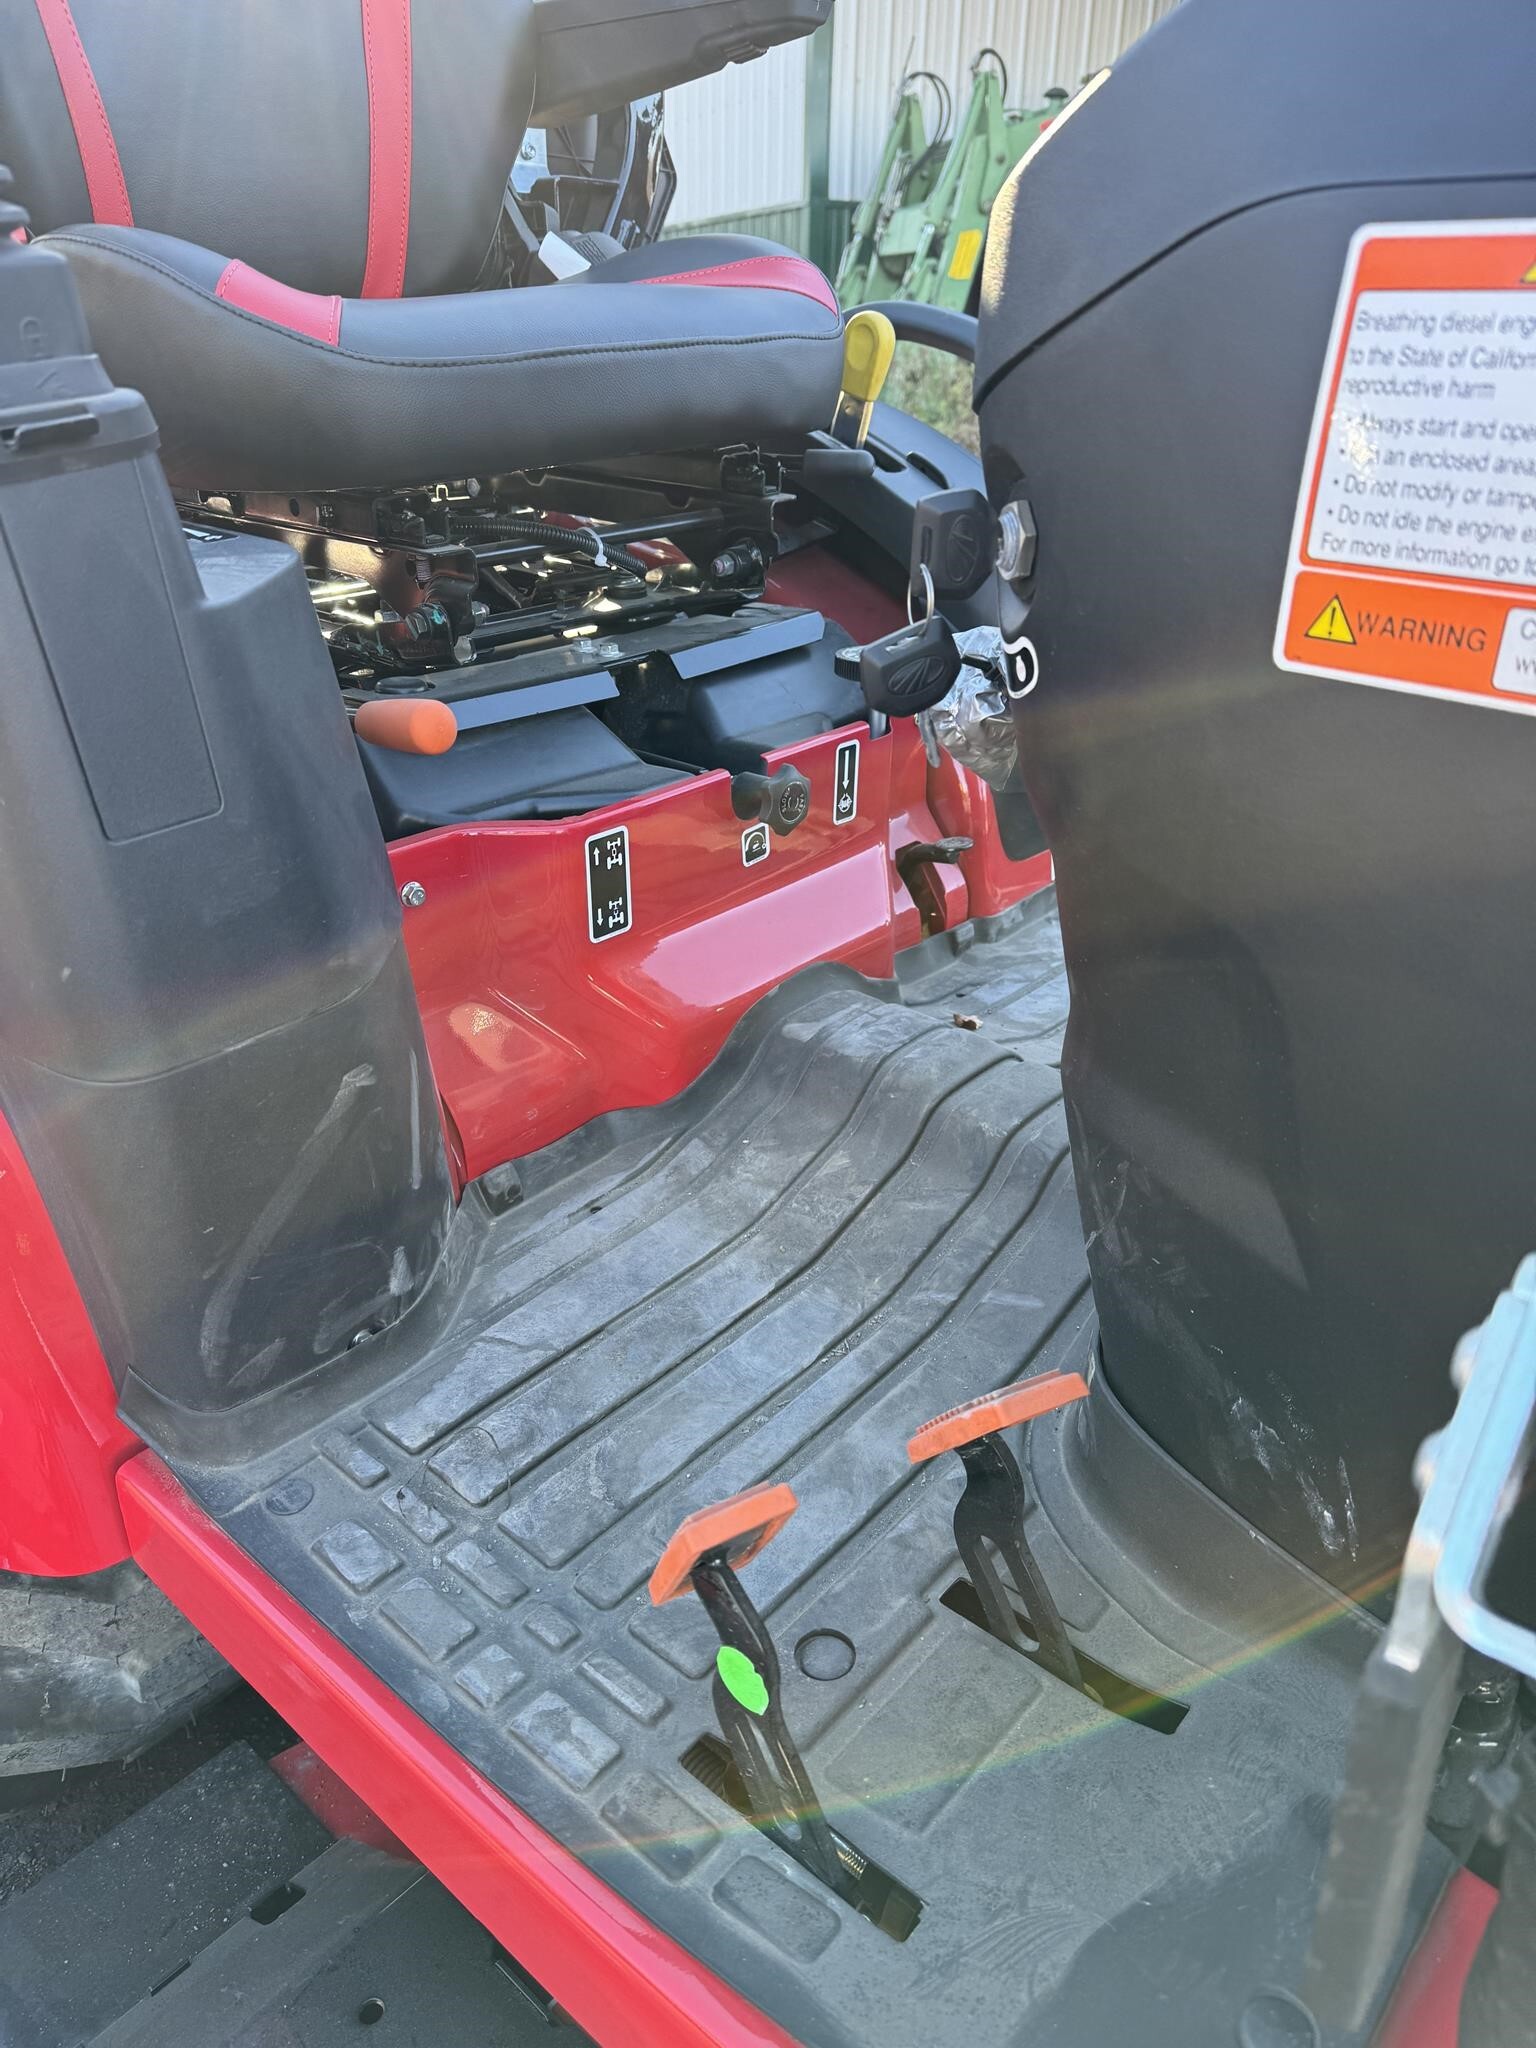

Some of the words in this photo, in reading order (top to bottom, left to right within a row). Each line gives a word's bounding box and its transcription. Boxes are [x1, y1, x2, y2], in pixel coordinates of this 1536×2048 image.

[1357, 309, 1436, 338] Breathing
[1440, 312, 1496, 334] diesel
[1368, 345, 1394, 367] the
[1399, 343, 1445, 368] State
[1448, 345, 1469, 368] of
[1344, 373, 1445, 399] reproductive
[1460, 417, 1498, 440] and
[1409, 449, 1491, 473] enclosed
[1343, 473, 1367, 495] Do
[1369, 479, 1398, 499] not
[1400, 481, 1457, 509] modify
[1462, 487, 1482, 505] or
[1338, 503, 1360, 526] Do
[1363, 510, 1390, 529] not
[1392, 508, 1422, 532] idle
[1424, 514, 1453, 535] the
[1456, 520, 1517, 544] engine
[1320, 531, 1347, 553] For
[1350, 538, 1391, 558] more
[1394, 541, 1491, 571] information
[1493, 555, 1520, 577] go
[1356, 610, 1488, 653] WARNING
